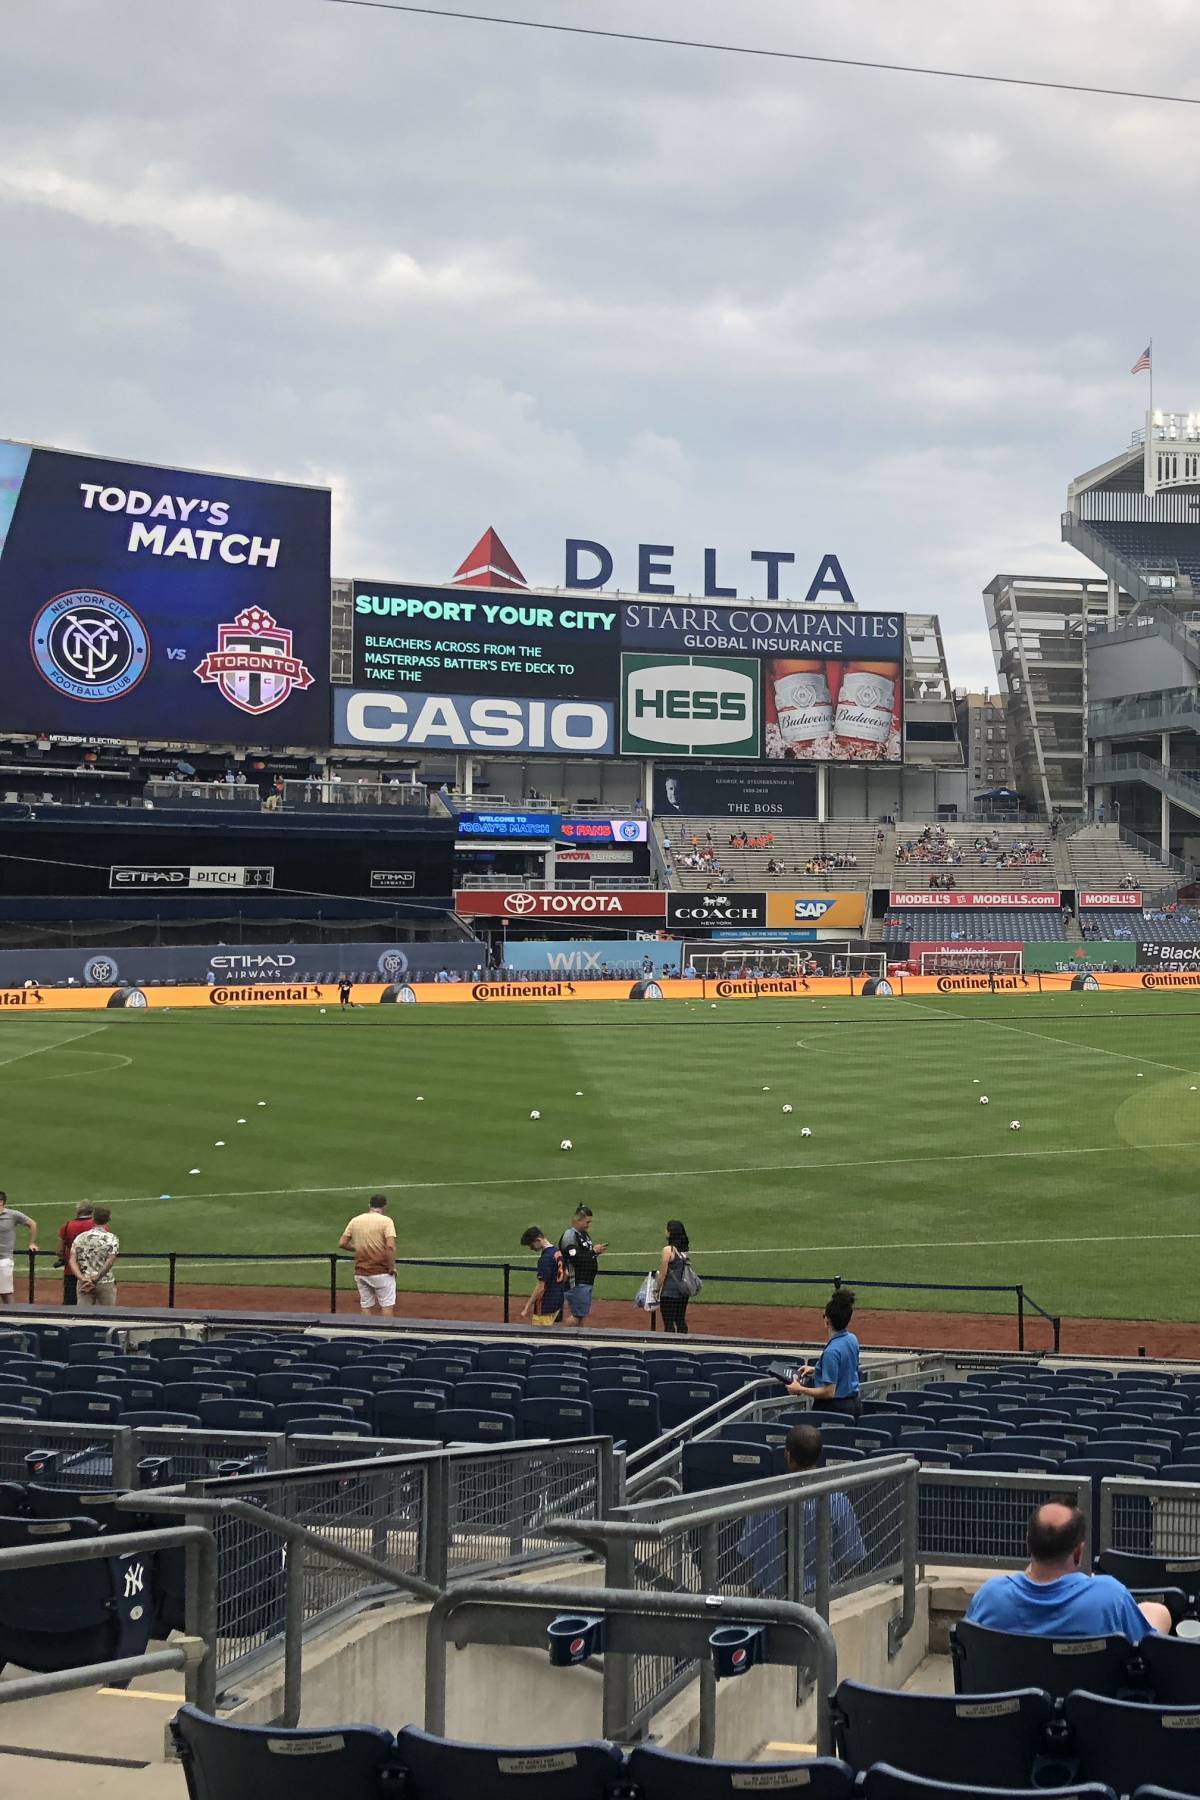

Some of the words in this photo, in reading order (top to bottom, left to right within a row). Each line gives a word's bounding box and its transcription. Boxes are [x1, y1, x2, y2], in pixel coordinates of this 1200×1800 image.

[80, 483, 230, 526] TODAY'S
[127, 521, 281, 568] MATCH
[565, 538, 855, 602] DELTA
[50, 598, 74, 614] NEW
[76, 595, 105, 606] YORK
[108, 602, 131, 620] CITY
[355, 594, 476, 622] SUPPORT
[481, 604, 553, 627] YOUR
[559, 610, 616, 631] CITY
[625, 605, 720, 631] STARR
[729, 611, 898, 638] COMPANIES
[365, 635, 432, 651] BLEACHERS
[435, 640, 480, 654] ACROSS
[483, 643, 516, 656] FROM
[518, 646, 542, 658] THE
[683, 634, 748, 650] GLOBAL
[752, 638, 843, 653] INSURANCE
[213, 655, 296, 675] TORONTO
[365, 653, 441, 668] MASTERPASS
[444, 657, 498, 671] BATTER'S
[501, 661, 522, 673] EYE
[525, 662, 556, 675] DECK
[557, 664, 575, 675] TO
[50, 671, 105, 697] FOOTBALL
[107, 675, 131, 694] CLUB
[364, 668, 395, 681] TAKE
[398, 670, 422, 682] THE
[635, 688, 746, 721] HESS
[346, 692, 608, 750] CASIO
[836, 708, 889, 728] Budweiser
[50, 734, 87, 743] MITSUBISHI
[89, 736, 122, 745] ELECTRIC
[728, 803, 750, 813] THE
[754, 803, 783, 813] BOSS
[458, 822, 507, 833] TODAY'S
[510, 823, 550, 834] MATCH
[479, 815, 515, 823] WELCOME
[577, 825, 612, 836] FANS
[115, 871, 184, 882] ETIHAD
[197, 871, 236, 883] PITCH
[372, 873, 413, 882] ETIHAD
[539, 895, 622, 913] TOYOTA
[895, 894, 951, 904] MODELL'S
[973, 895, 1055, 905] MODELLS.com
[1085, 895, 1136, 905] MODELL'S
[675, 908, 759, 919] COACH
[795, 903, 827, 918] SAP
[210, 954, 295, 968] ETIHAD
[226, 969, 281, 979] AIRWAYS
[472, 982, 562, 1001] Continental
[716, 980, 797, 997] Continental
[937, 977, 1018, 993] Continental
[209, 986, 308, 1005] Continental
